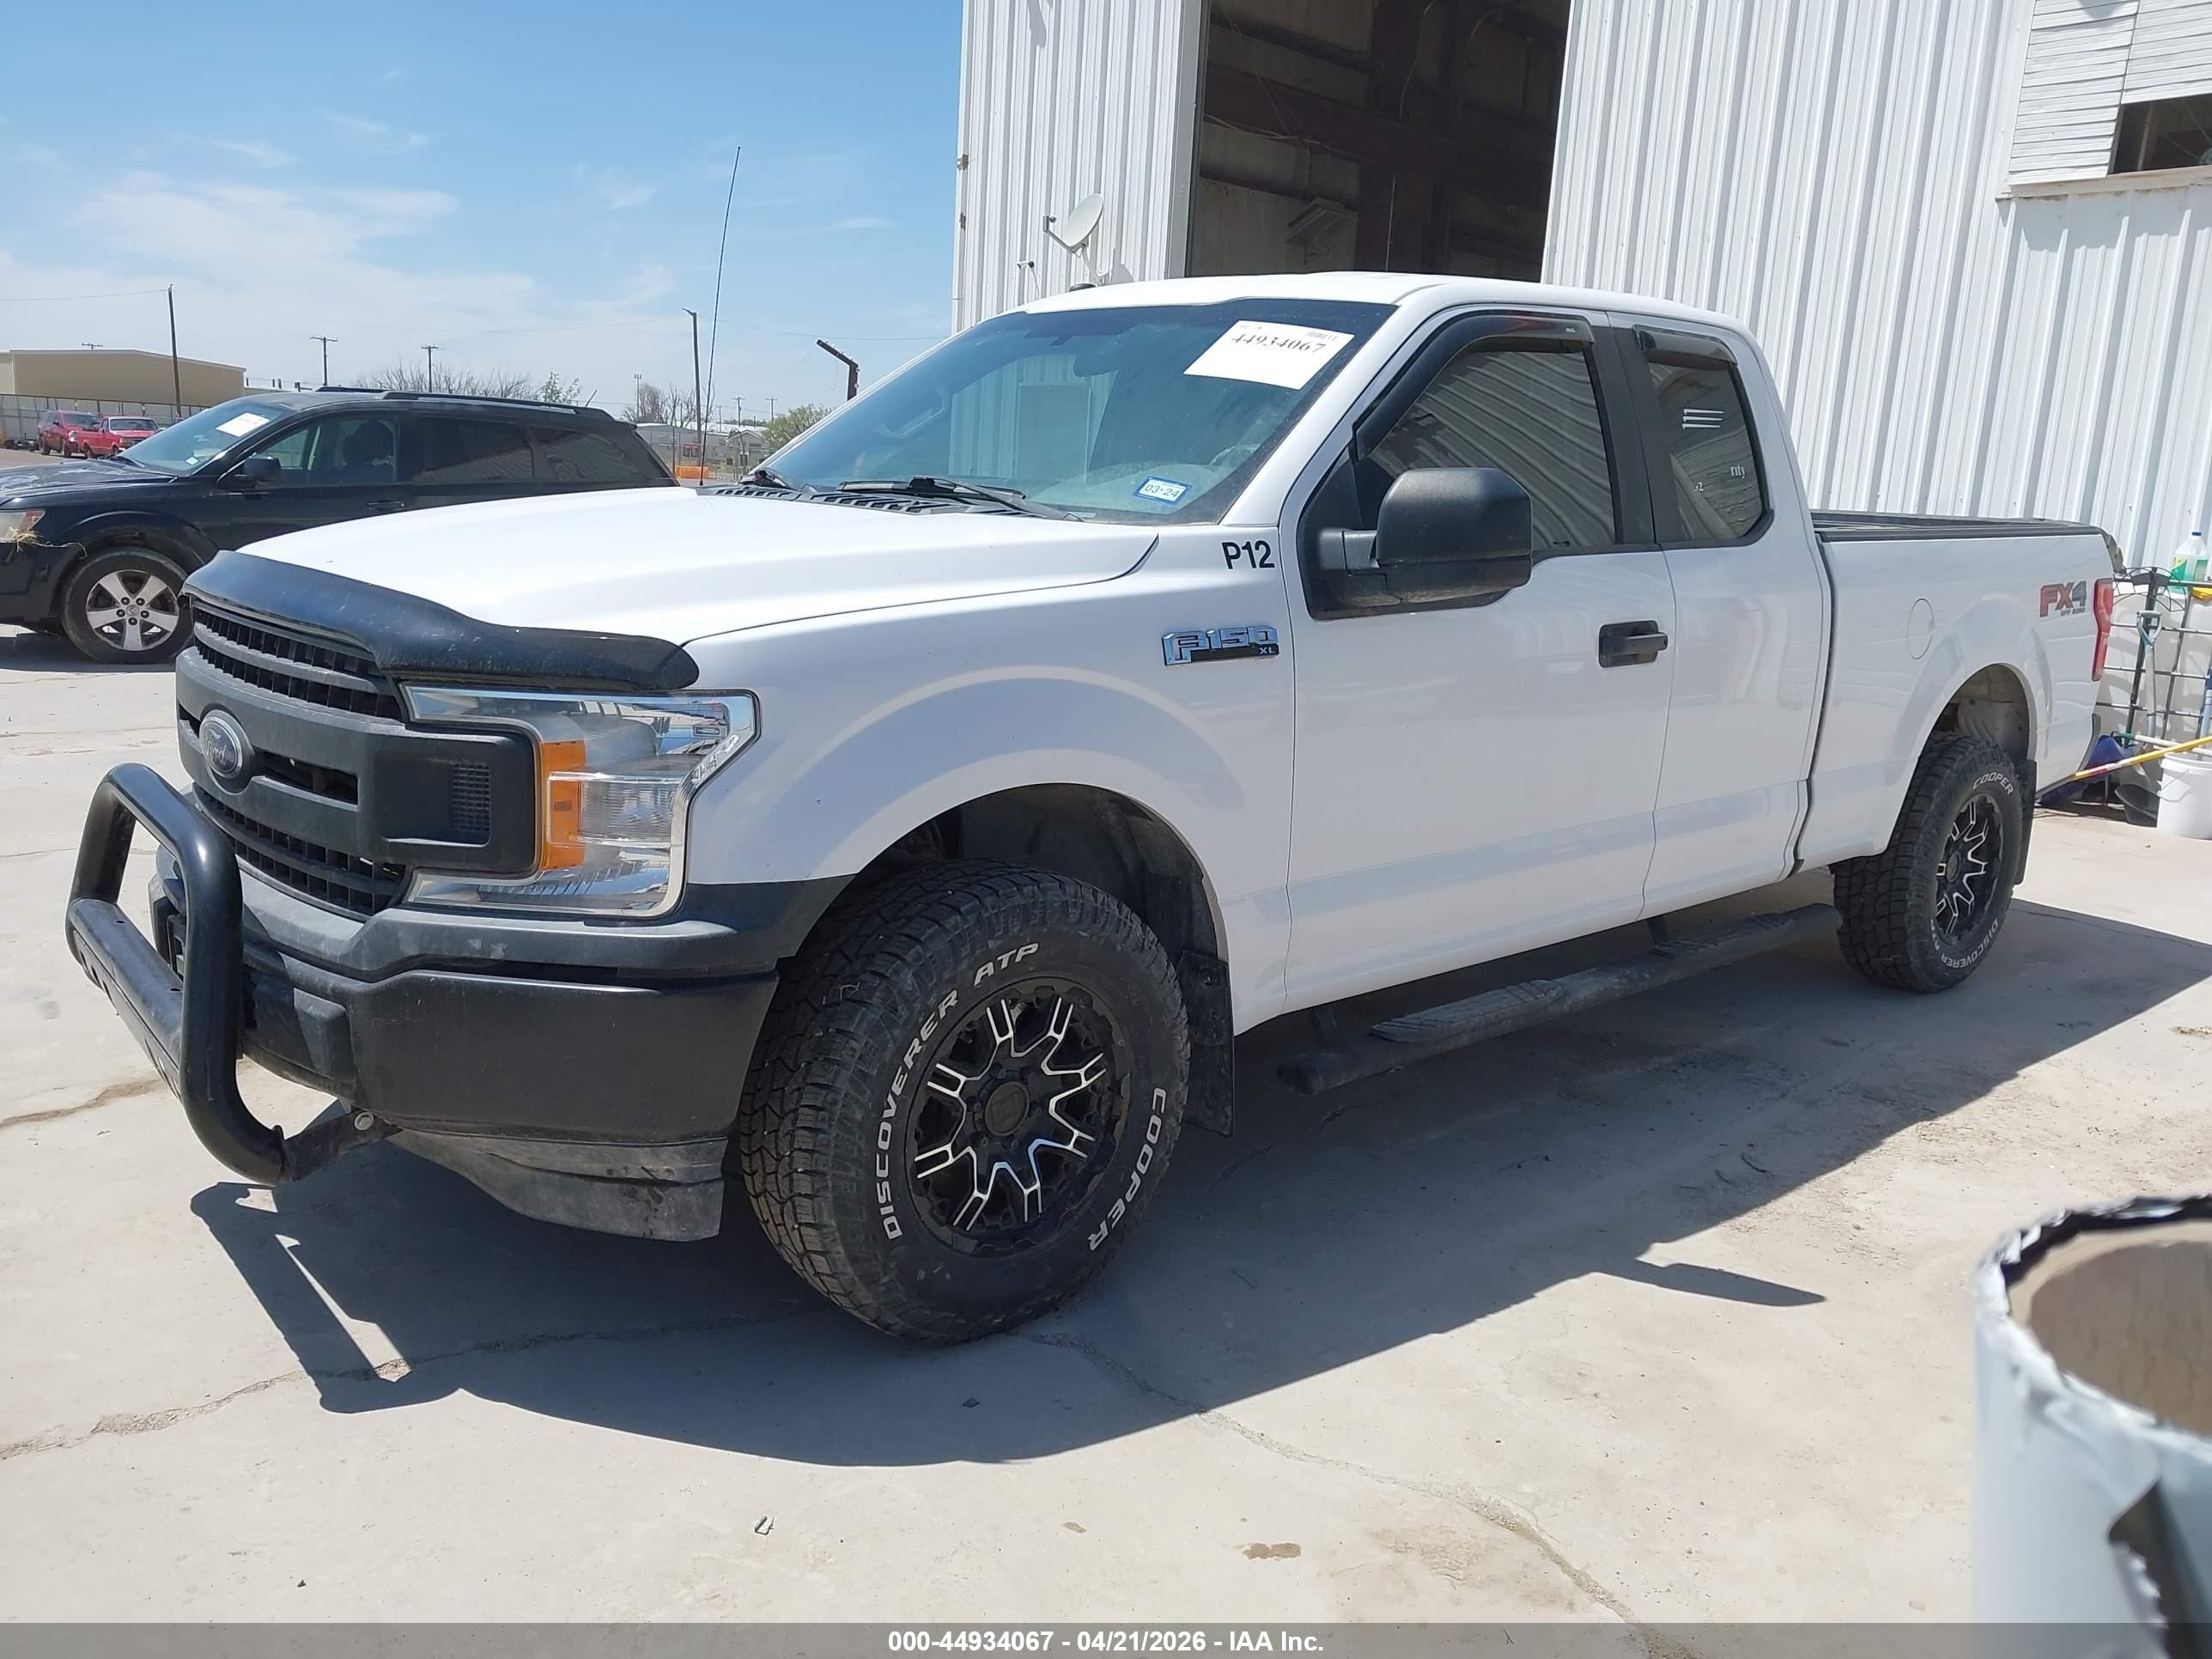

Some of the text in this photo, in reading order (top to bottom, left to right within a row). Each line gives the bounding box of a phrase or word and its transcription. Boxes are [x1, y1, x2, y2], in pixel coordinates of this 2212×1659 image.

[1231, 333, 1326, 353] 44934067
[1145, 484, 1180, 497] 03 24
[1222, 540, 1275, 569] P12
[2039, 580, 2087, 617] FX4
[1162, 626, 1279, 665] F150
[205, 728, 228, 766] Ford
[1972, 772, 2014, 796] COOPER
[1941, 918, 1999, 981] DISCOVERER
[875, 943, 1039, 1240] DISCOVERER ATP
[1086, 1087, 1167, 1251] COOPER
